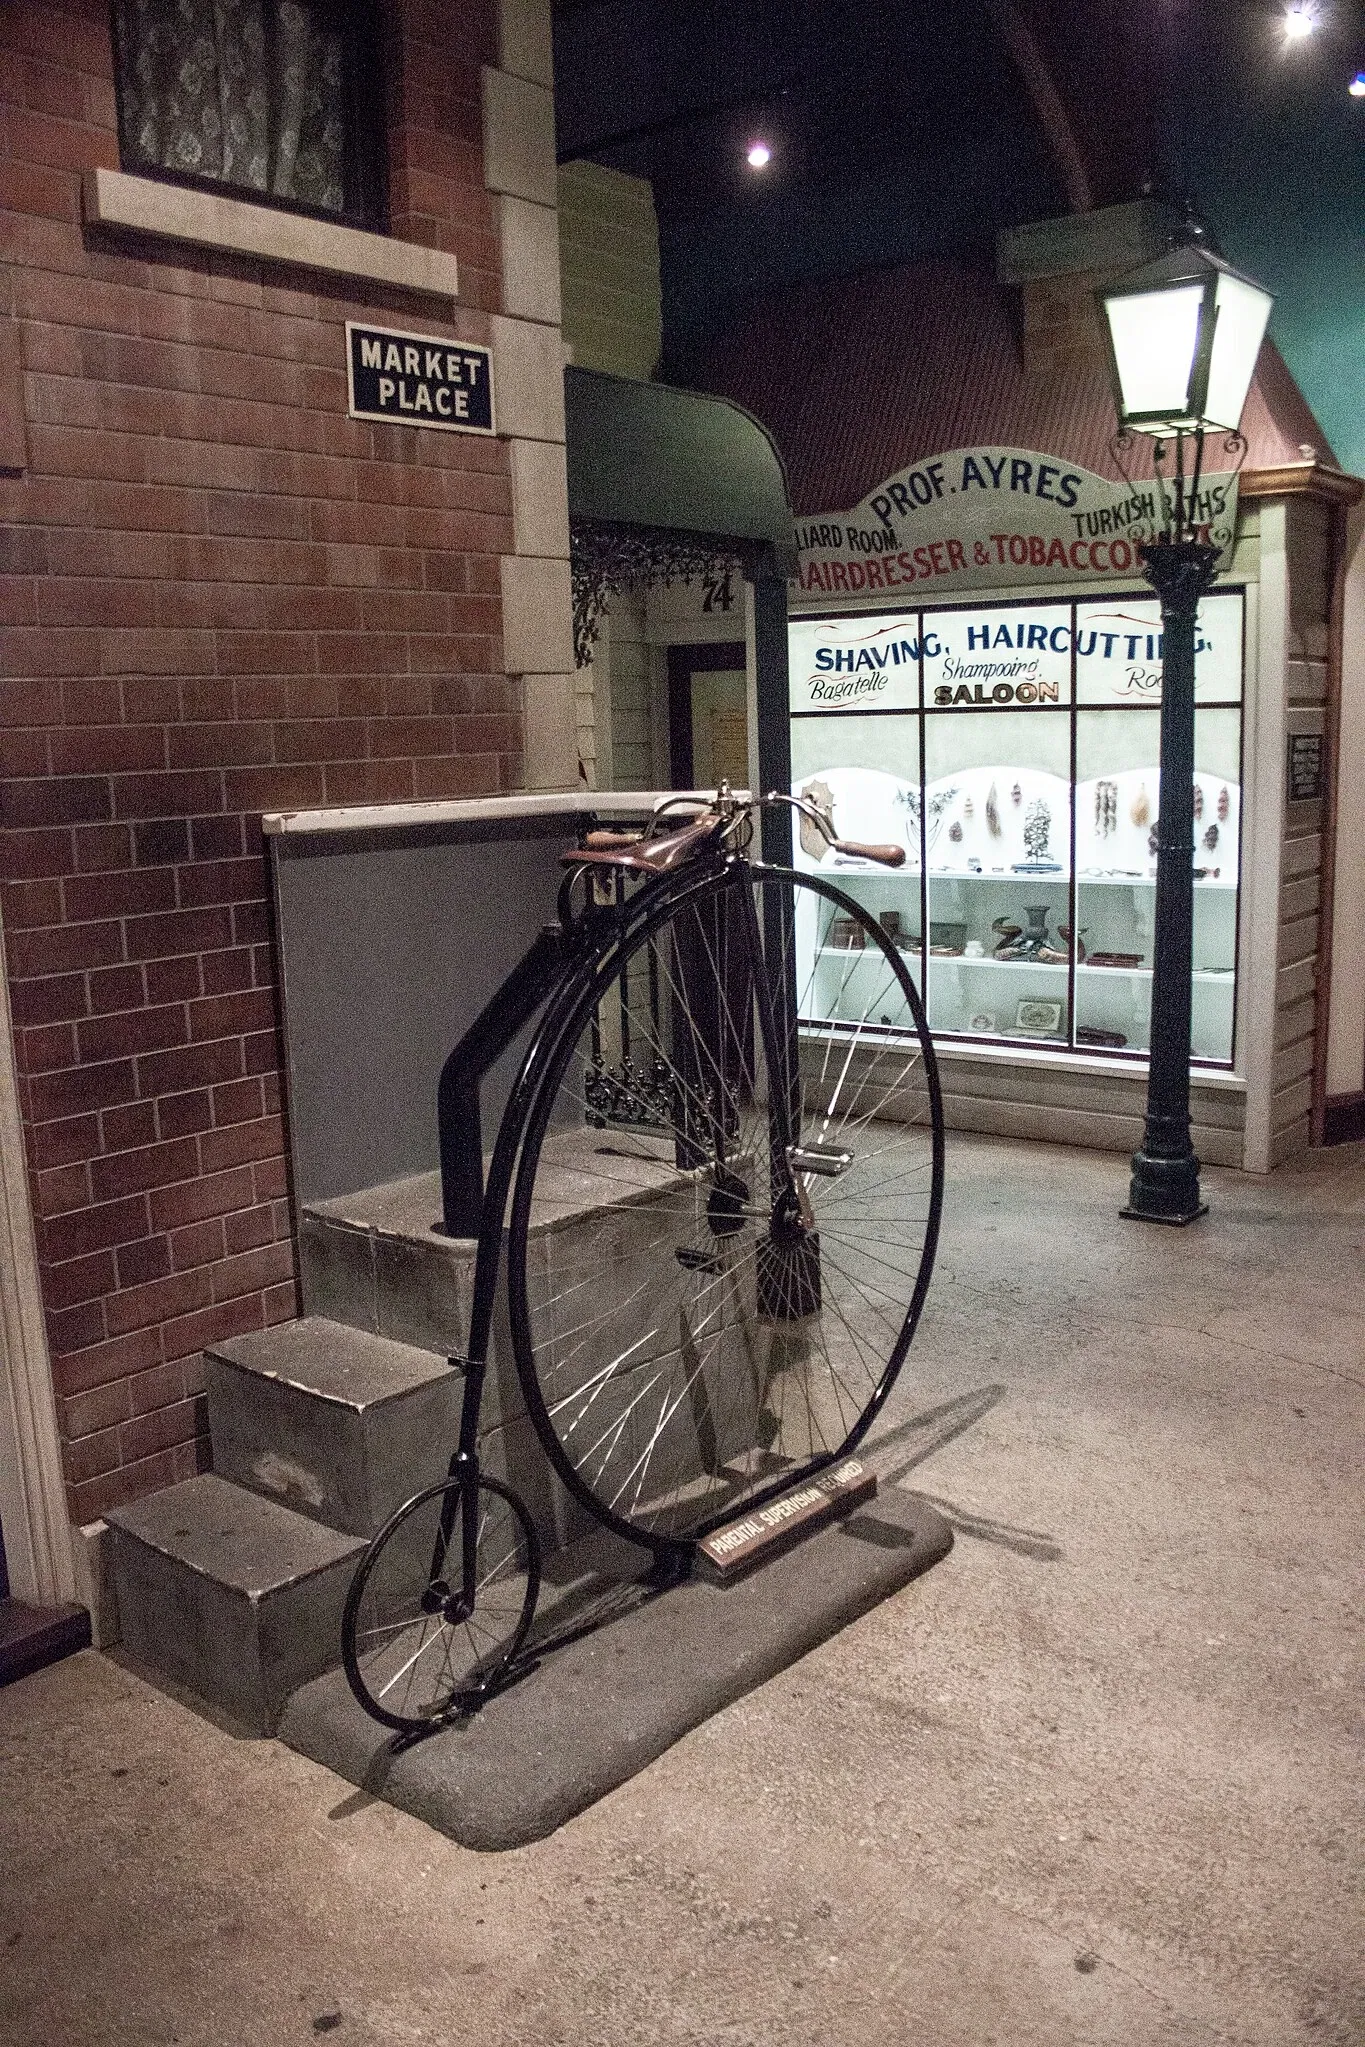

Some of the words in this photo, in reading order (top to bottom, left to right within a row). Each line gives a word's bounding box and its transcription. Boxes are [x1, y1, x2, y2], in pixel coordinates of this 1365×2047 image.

[361, 338, 482, 386] MARKET
[379, 377, 470, 418] PLACE
[868, 461, 956, 528] PROF.
[961, 456, 1082, 508] AYRES
[1071, 492, 1155, 538] TURKISH
[974, 540, 990, 566] &
[702, 571, 735, 612] 74
[815, 633, 950, 672] SHAVING,
[808, 671, 889, 701] Bagatelle
[934, 682, 1059, 706] SALOON
[709, 1520, 766, 1556] PARENTAL
[759, 1487, 822, 1527] SUPERVISION
